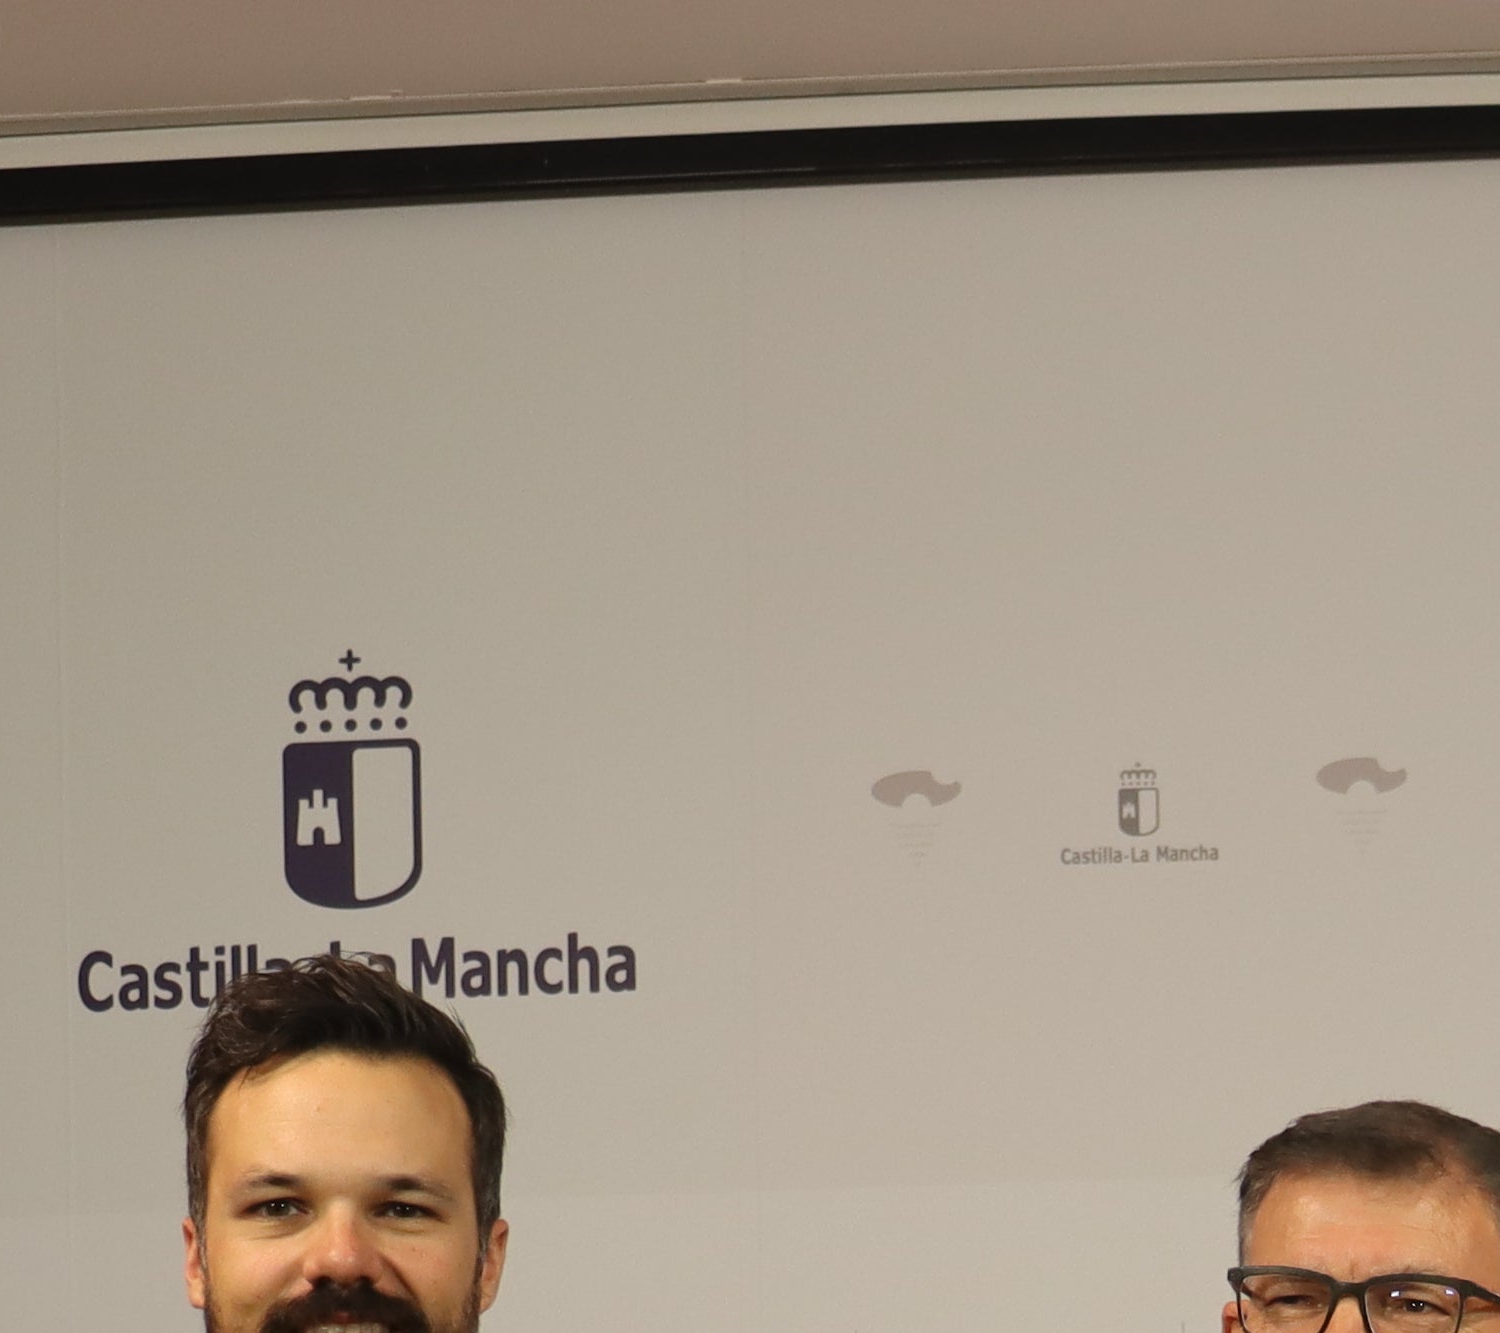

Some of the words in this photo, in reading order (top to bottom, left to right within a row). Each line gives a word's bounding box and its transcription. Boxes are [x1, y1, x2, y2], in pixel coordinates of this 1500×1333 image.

[1060, 846, 1150, 865] Castilla-La
[1155, 843, 1220, 863] Mancha
[410, 931, 638, 1001] Mancha
